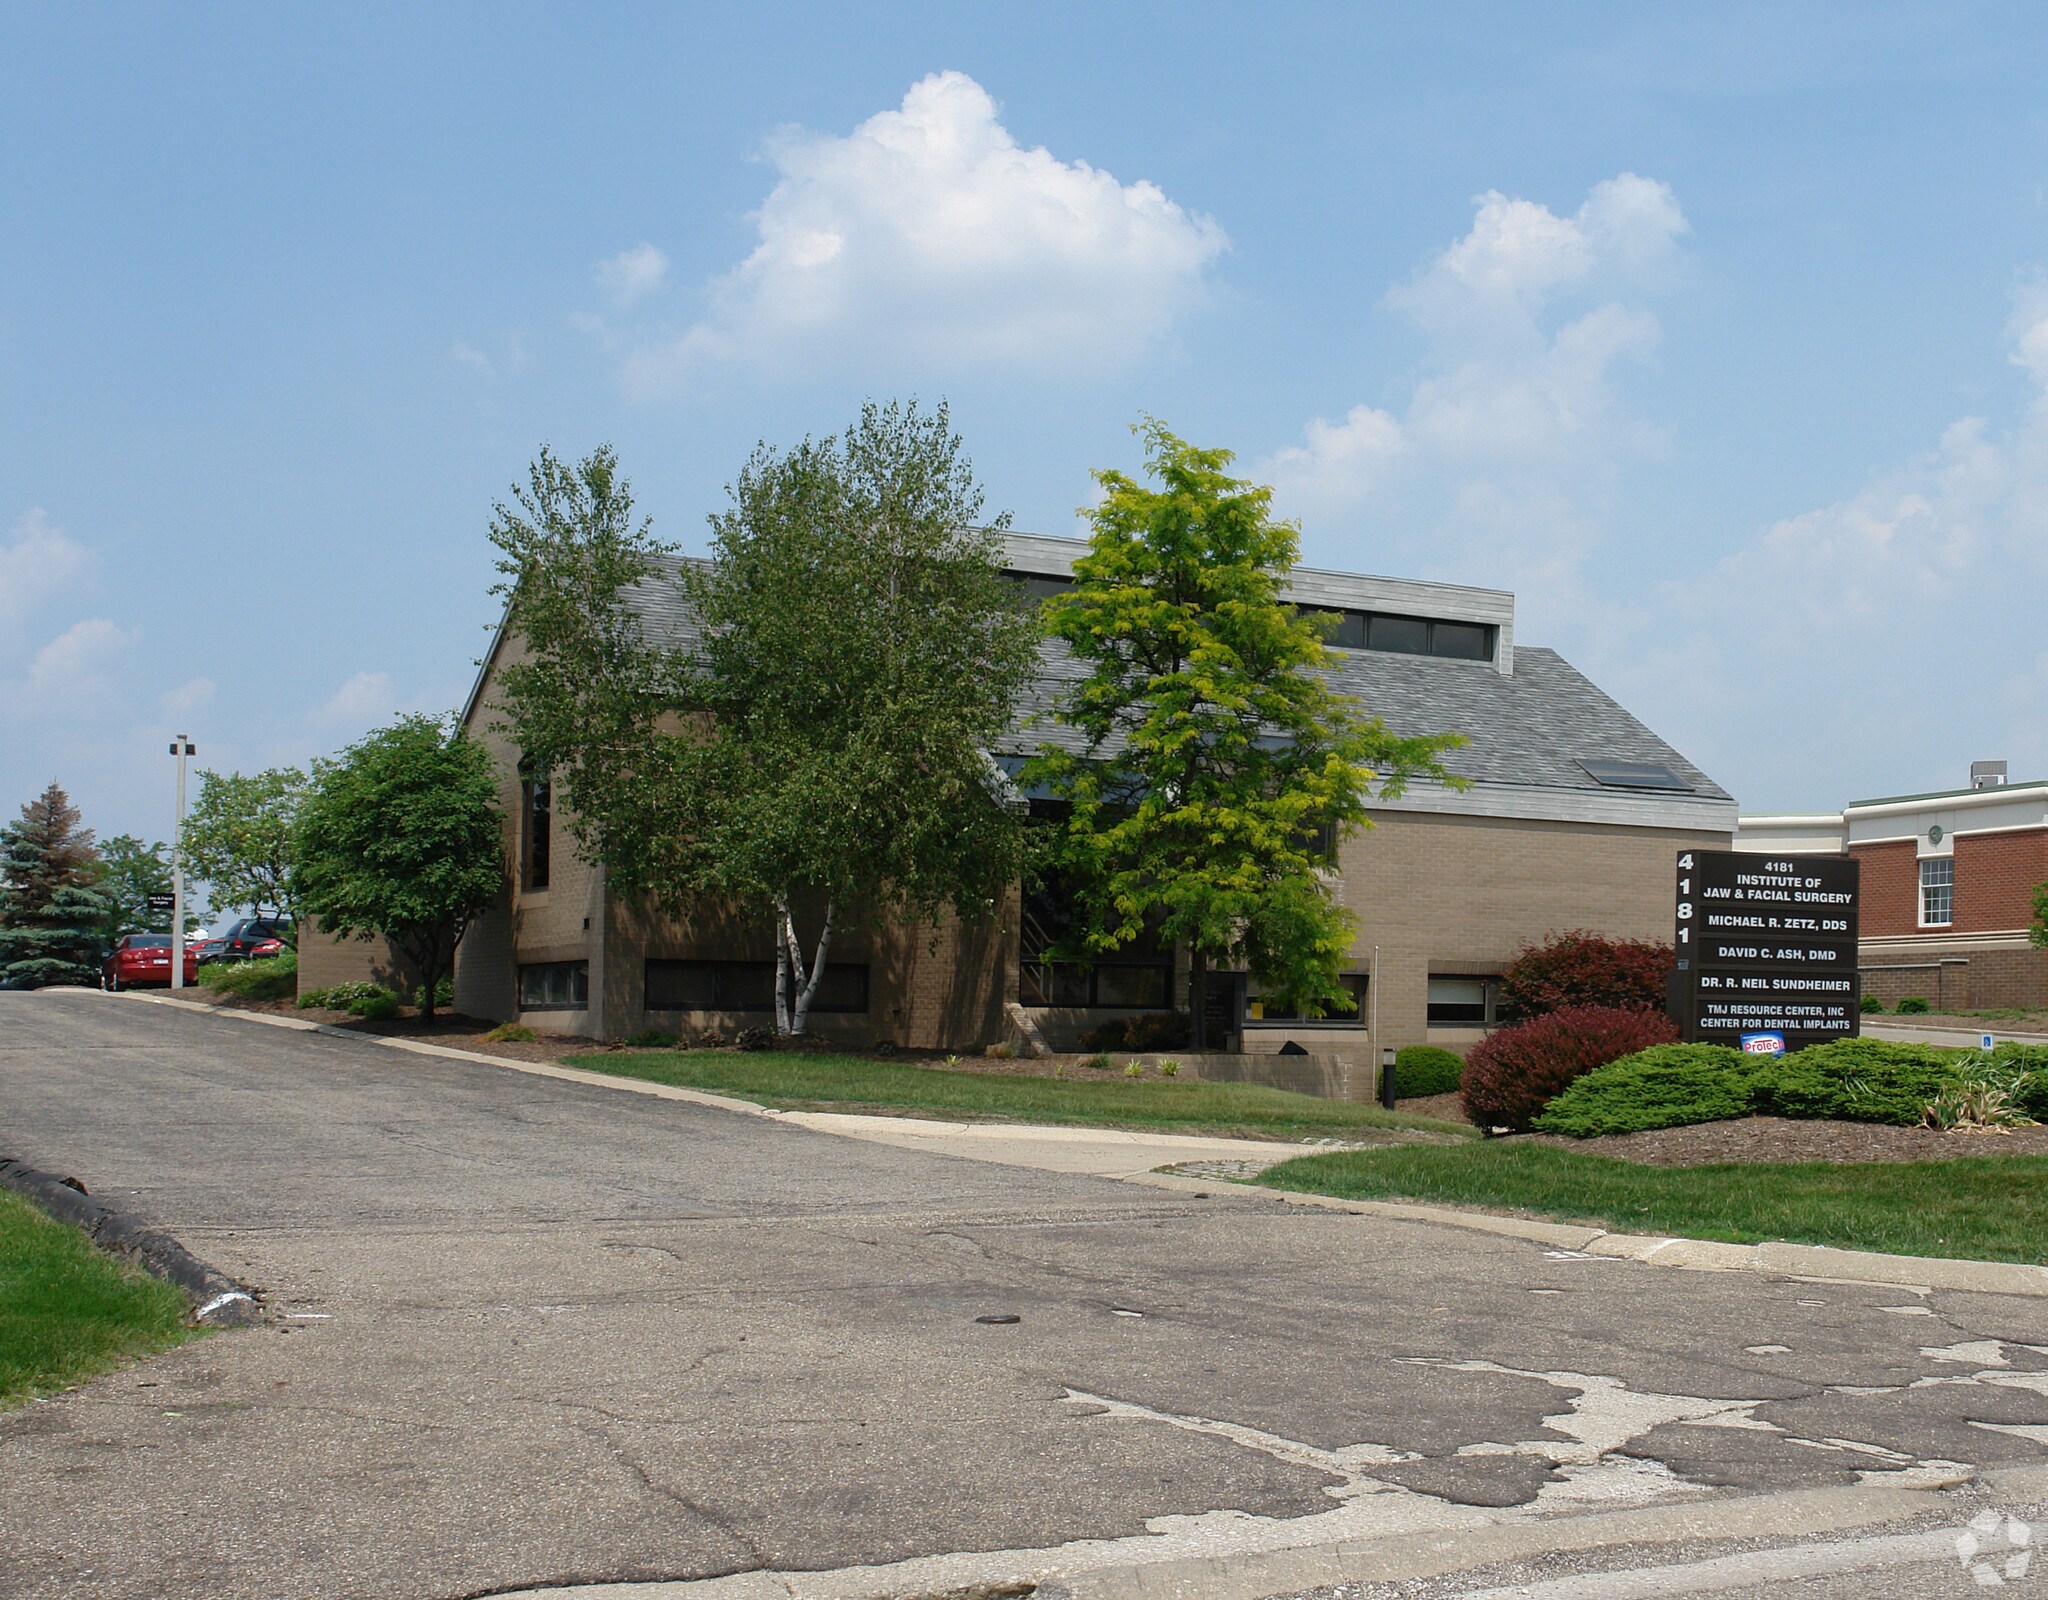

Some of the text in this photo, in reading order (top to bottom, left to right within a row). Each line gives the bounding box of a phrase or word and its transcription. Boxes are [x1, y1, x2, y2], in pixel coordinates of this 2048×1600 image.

[1764, 861, 1794, 873] 4181
[1737, 874, 1822, 889] INSTITUTE OF
[1703, 887, 1853, 904] JAW & FACIAL SURGERY
[1708, 915, 1848, 931] MICHAEL R. ZETZ, DDS
[1718, 947, 1837, 961] DAVID C. ASH, DMD
[1701, 976, 1851, 991] DR. R. NEIL SUNDHEIMER
[1707, 1004, 1845, 1017] TMJ RESOURCE CENTER, INC
[1700, 1017, 1850, 1030] CENTER FOR DENTAL IMPLANTS
